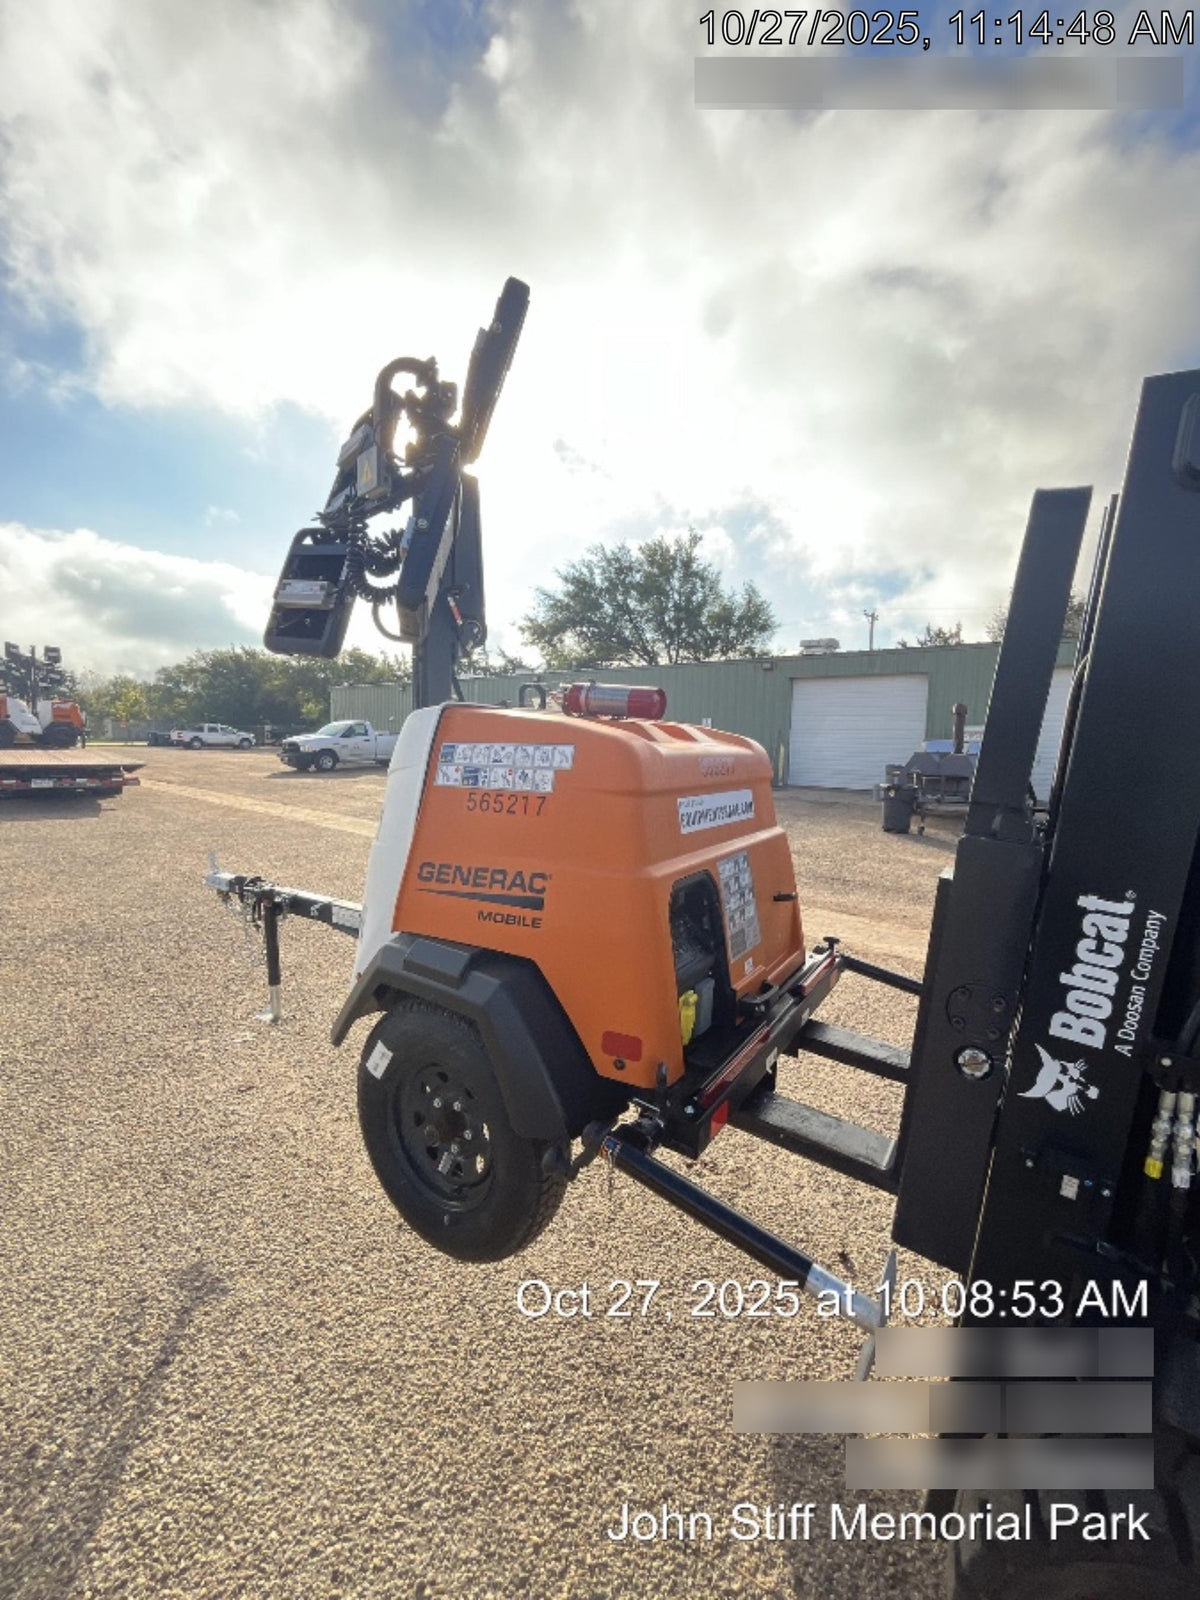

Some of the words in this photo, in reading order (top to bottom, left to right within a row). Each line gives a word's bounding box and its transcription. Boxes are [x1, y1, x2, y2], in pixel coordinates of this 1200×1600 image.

[466, 792, 547, 816] 565217
[417, 862, 549, 894] GENERAC
[477, 910, 543, 929] MOBILE
[1130, 909, 1167, 981] Company
[1118, 985, 1146, 1041] Doosan
[1114, 1042, 1132, 1057] A
